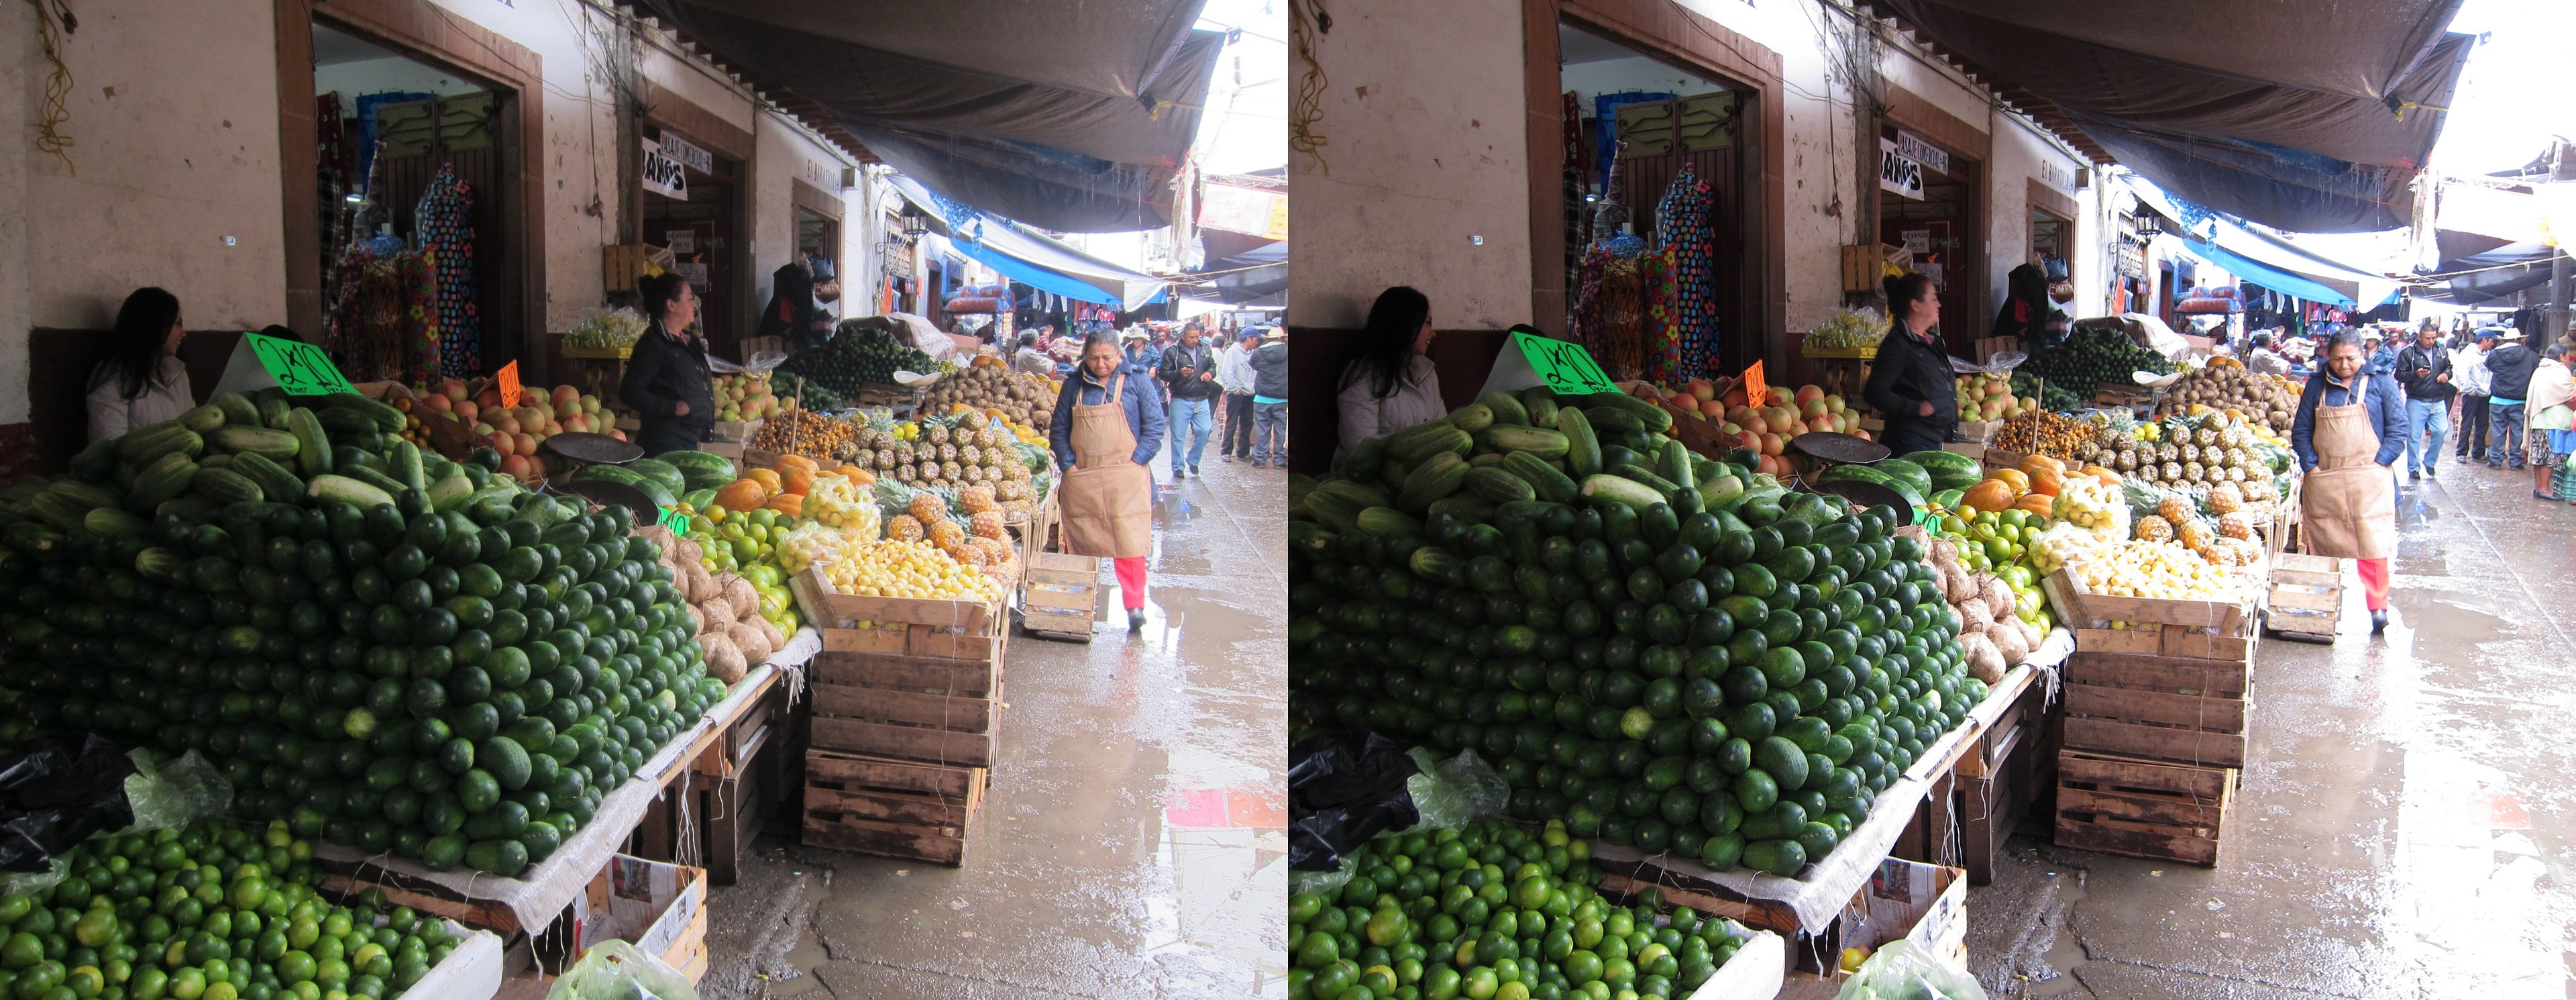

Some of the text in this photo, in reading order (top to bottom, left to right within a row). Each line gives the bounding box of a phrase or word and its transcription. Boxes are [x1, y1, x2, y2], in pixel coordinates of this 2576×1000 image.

[643, 148, 684, 191] AÑOS
[662, 134, 680, 158] PASAJE
[680, 142, 703, 169] COMERCIAL
[1880, 148, 1921, 191] AÑOS
[1898, 133, 1917, 158] PASAJE
[1917, 142, 1939, 169] COMERCIAL
